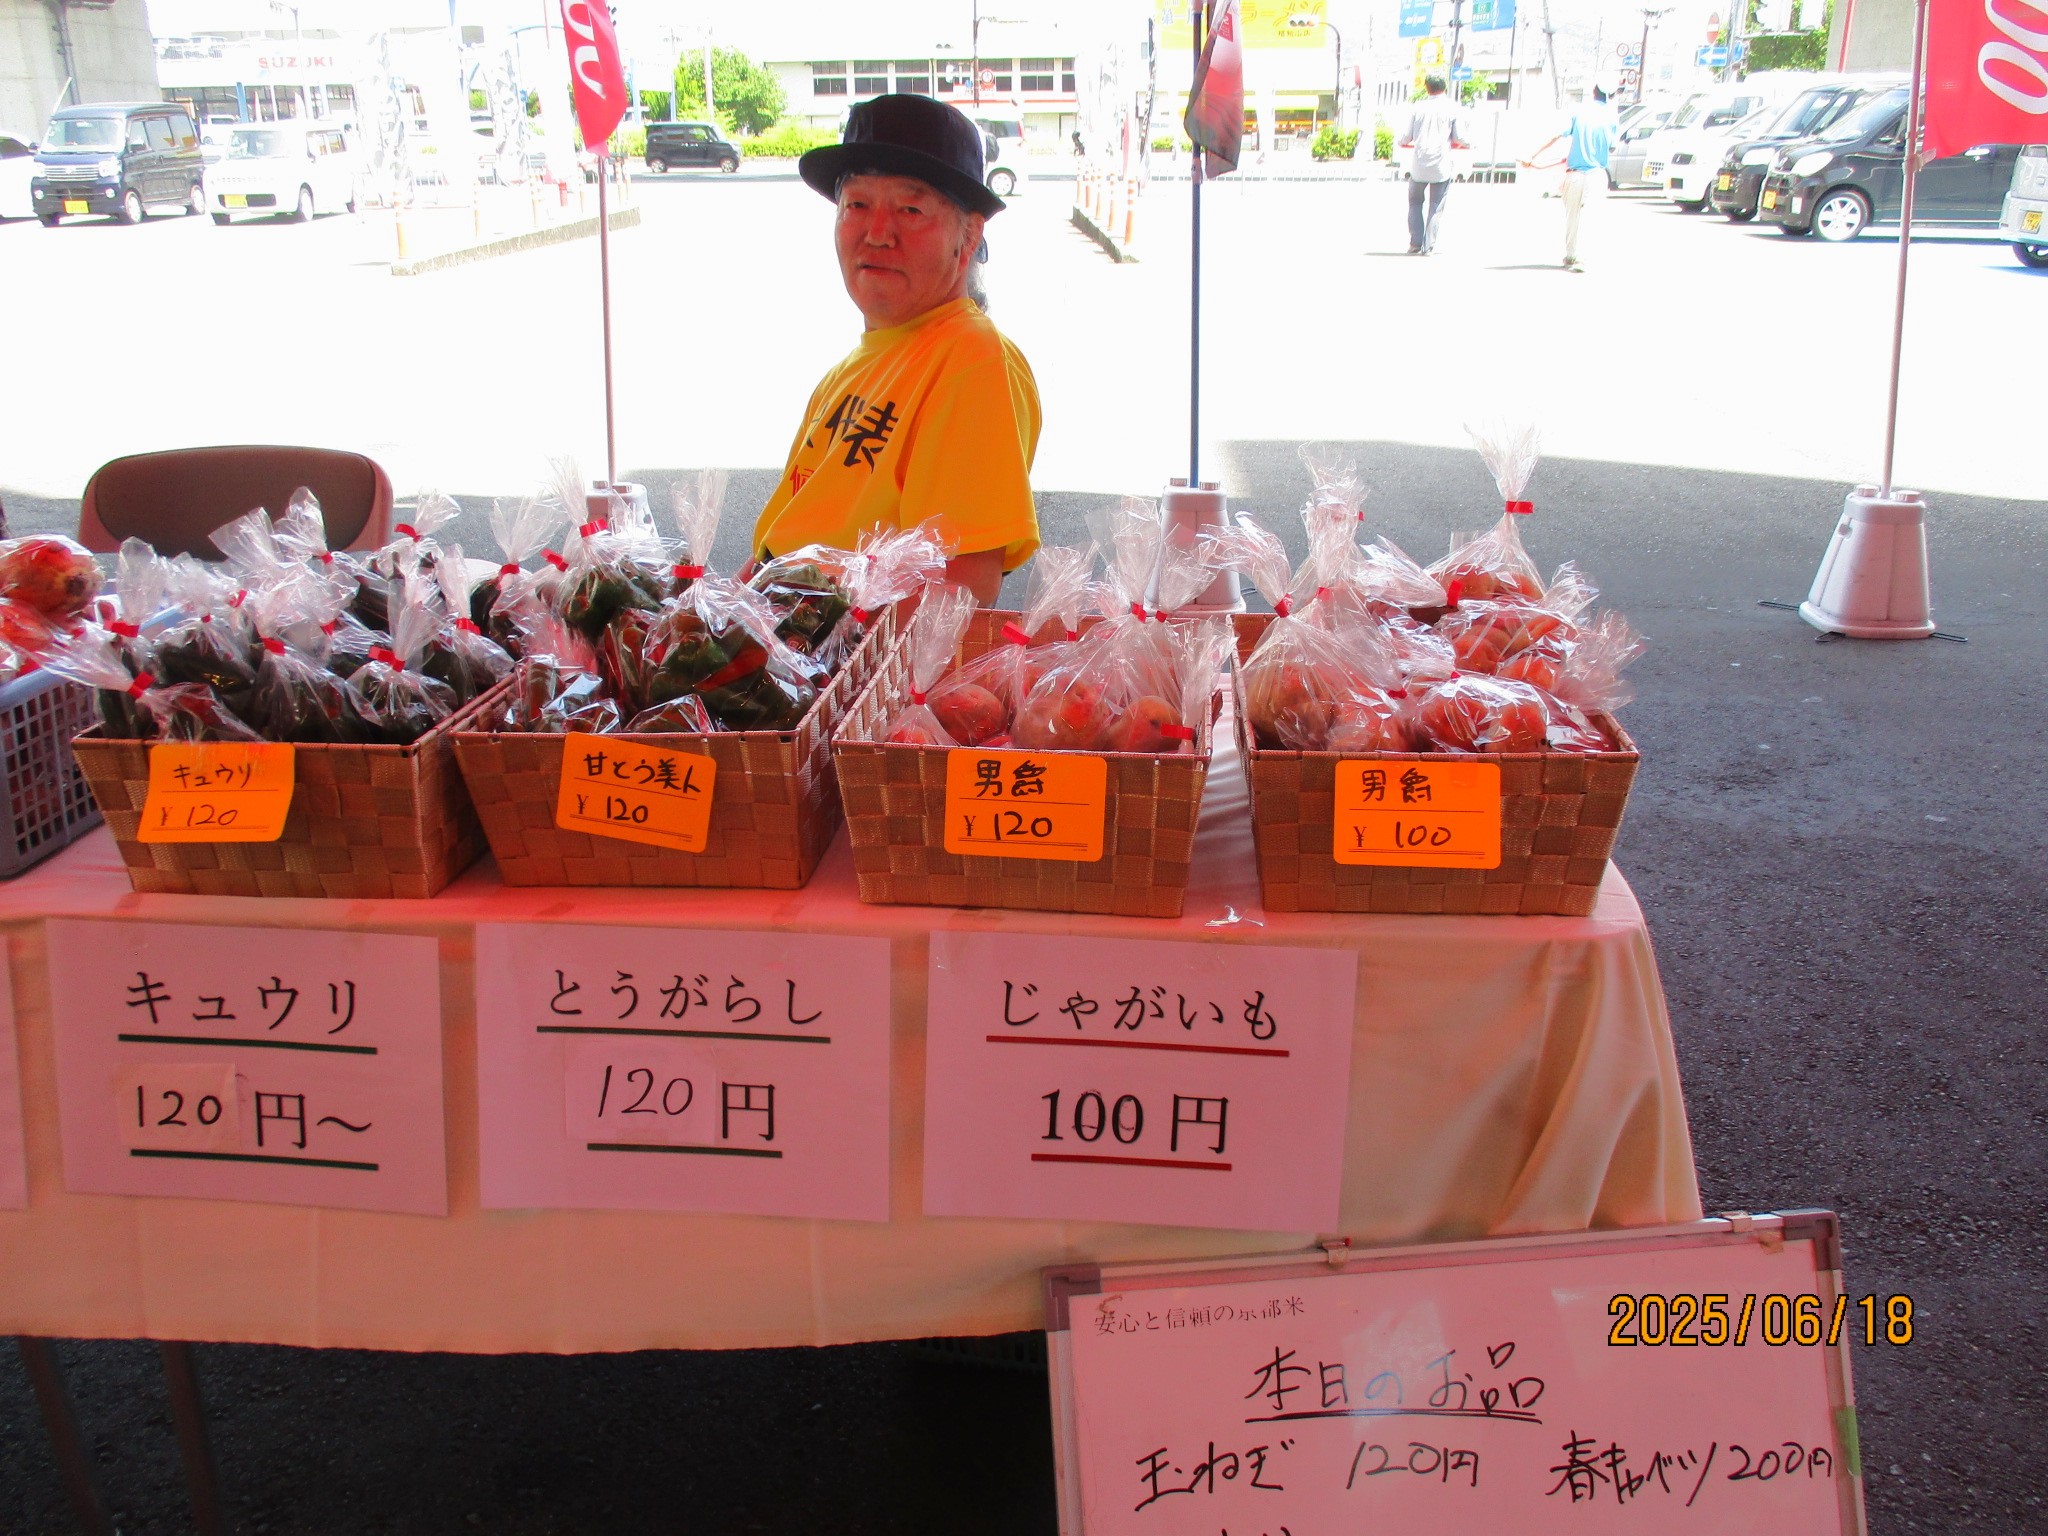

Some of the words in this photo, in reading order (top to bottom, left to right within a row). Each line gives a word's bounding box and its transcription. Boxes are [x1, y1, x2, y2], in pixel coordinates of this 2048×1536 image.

[173, 763, 252, 789] キュウリ
[583, 751, 701, 793] 甘とう美人
[974, 759, 1048, 797] 男爵
[1362, 767, 1432, 803] 男爵
[125, 971, 357, 1034] キュウリ
[549, 969, 823, 1026] とうがらし
[1002, 980, 1278, 1041] じゃがいも
[1245, 1342, 1546, 1415] 本日のお品
[1135, 1439, 1296, 1512] 玉ねぎ
[1346, 1441, 1480, 1490] 120円
